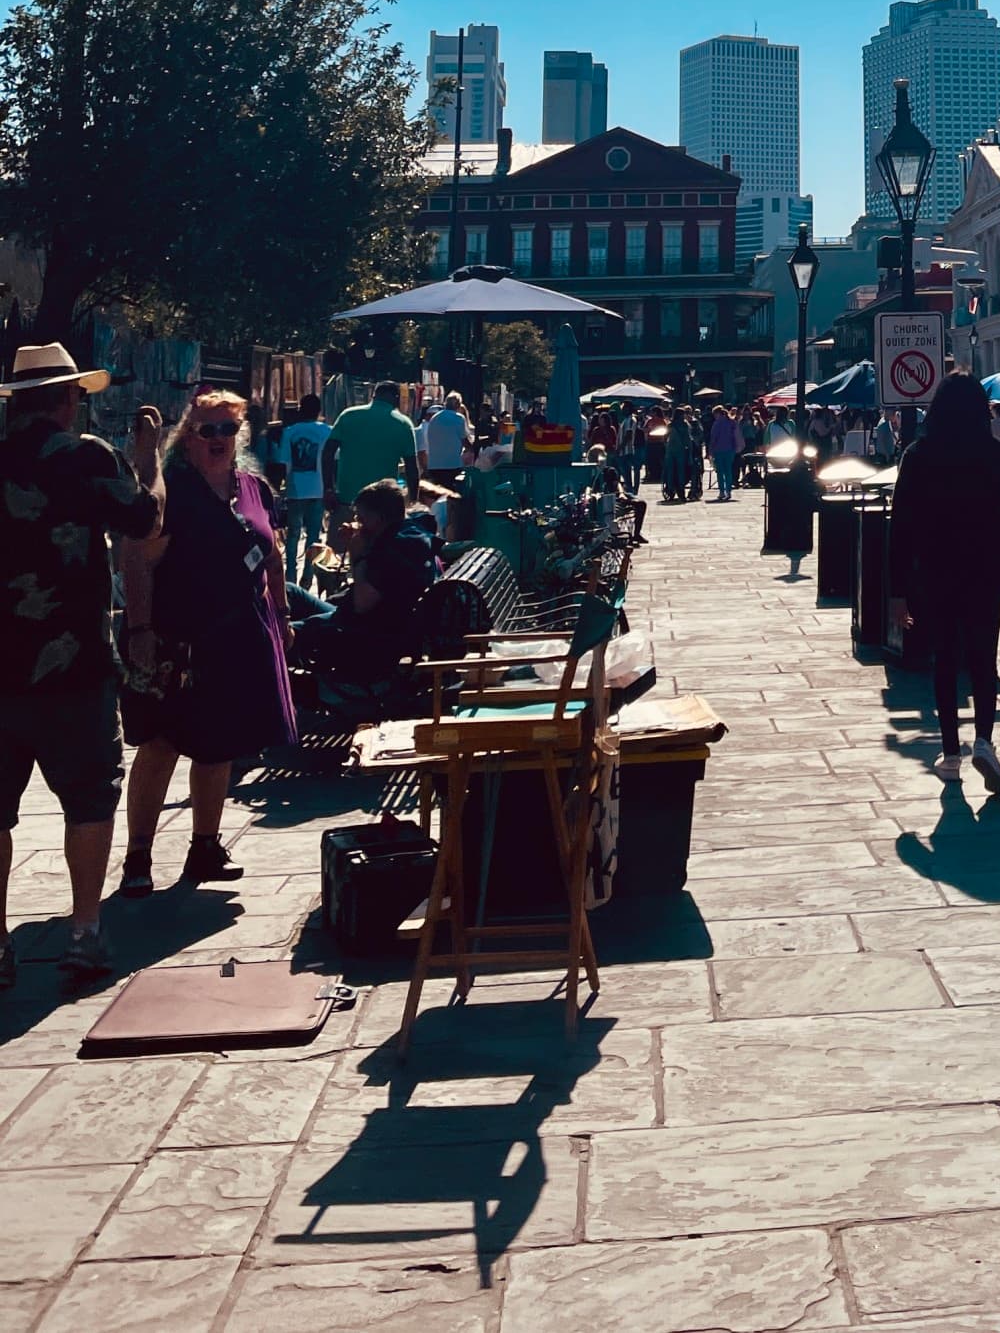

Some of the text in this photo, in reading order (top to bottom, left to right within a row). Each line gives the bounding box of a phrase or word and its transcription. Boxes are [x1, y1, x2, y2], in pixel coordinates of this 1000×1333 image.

[893, 324, 929, 334] CHURCH
[885, 337, 937, 347] QUIET ZONE
